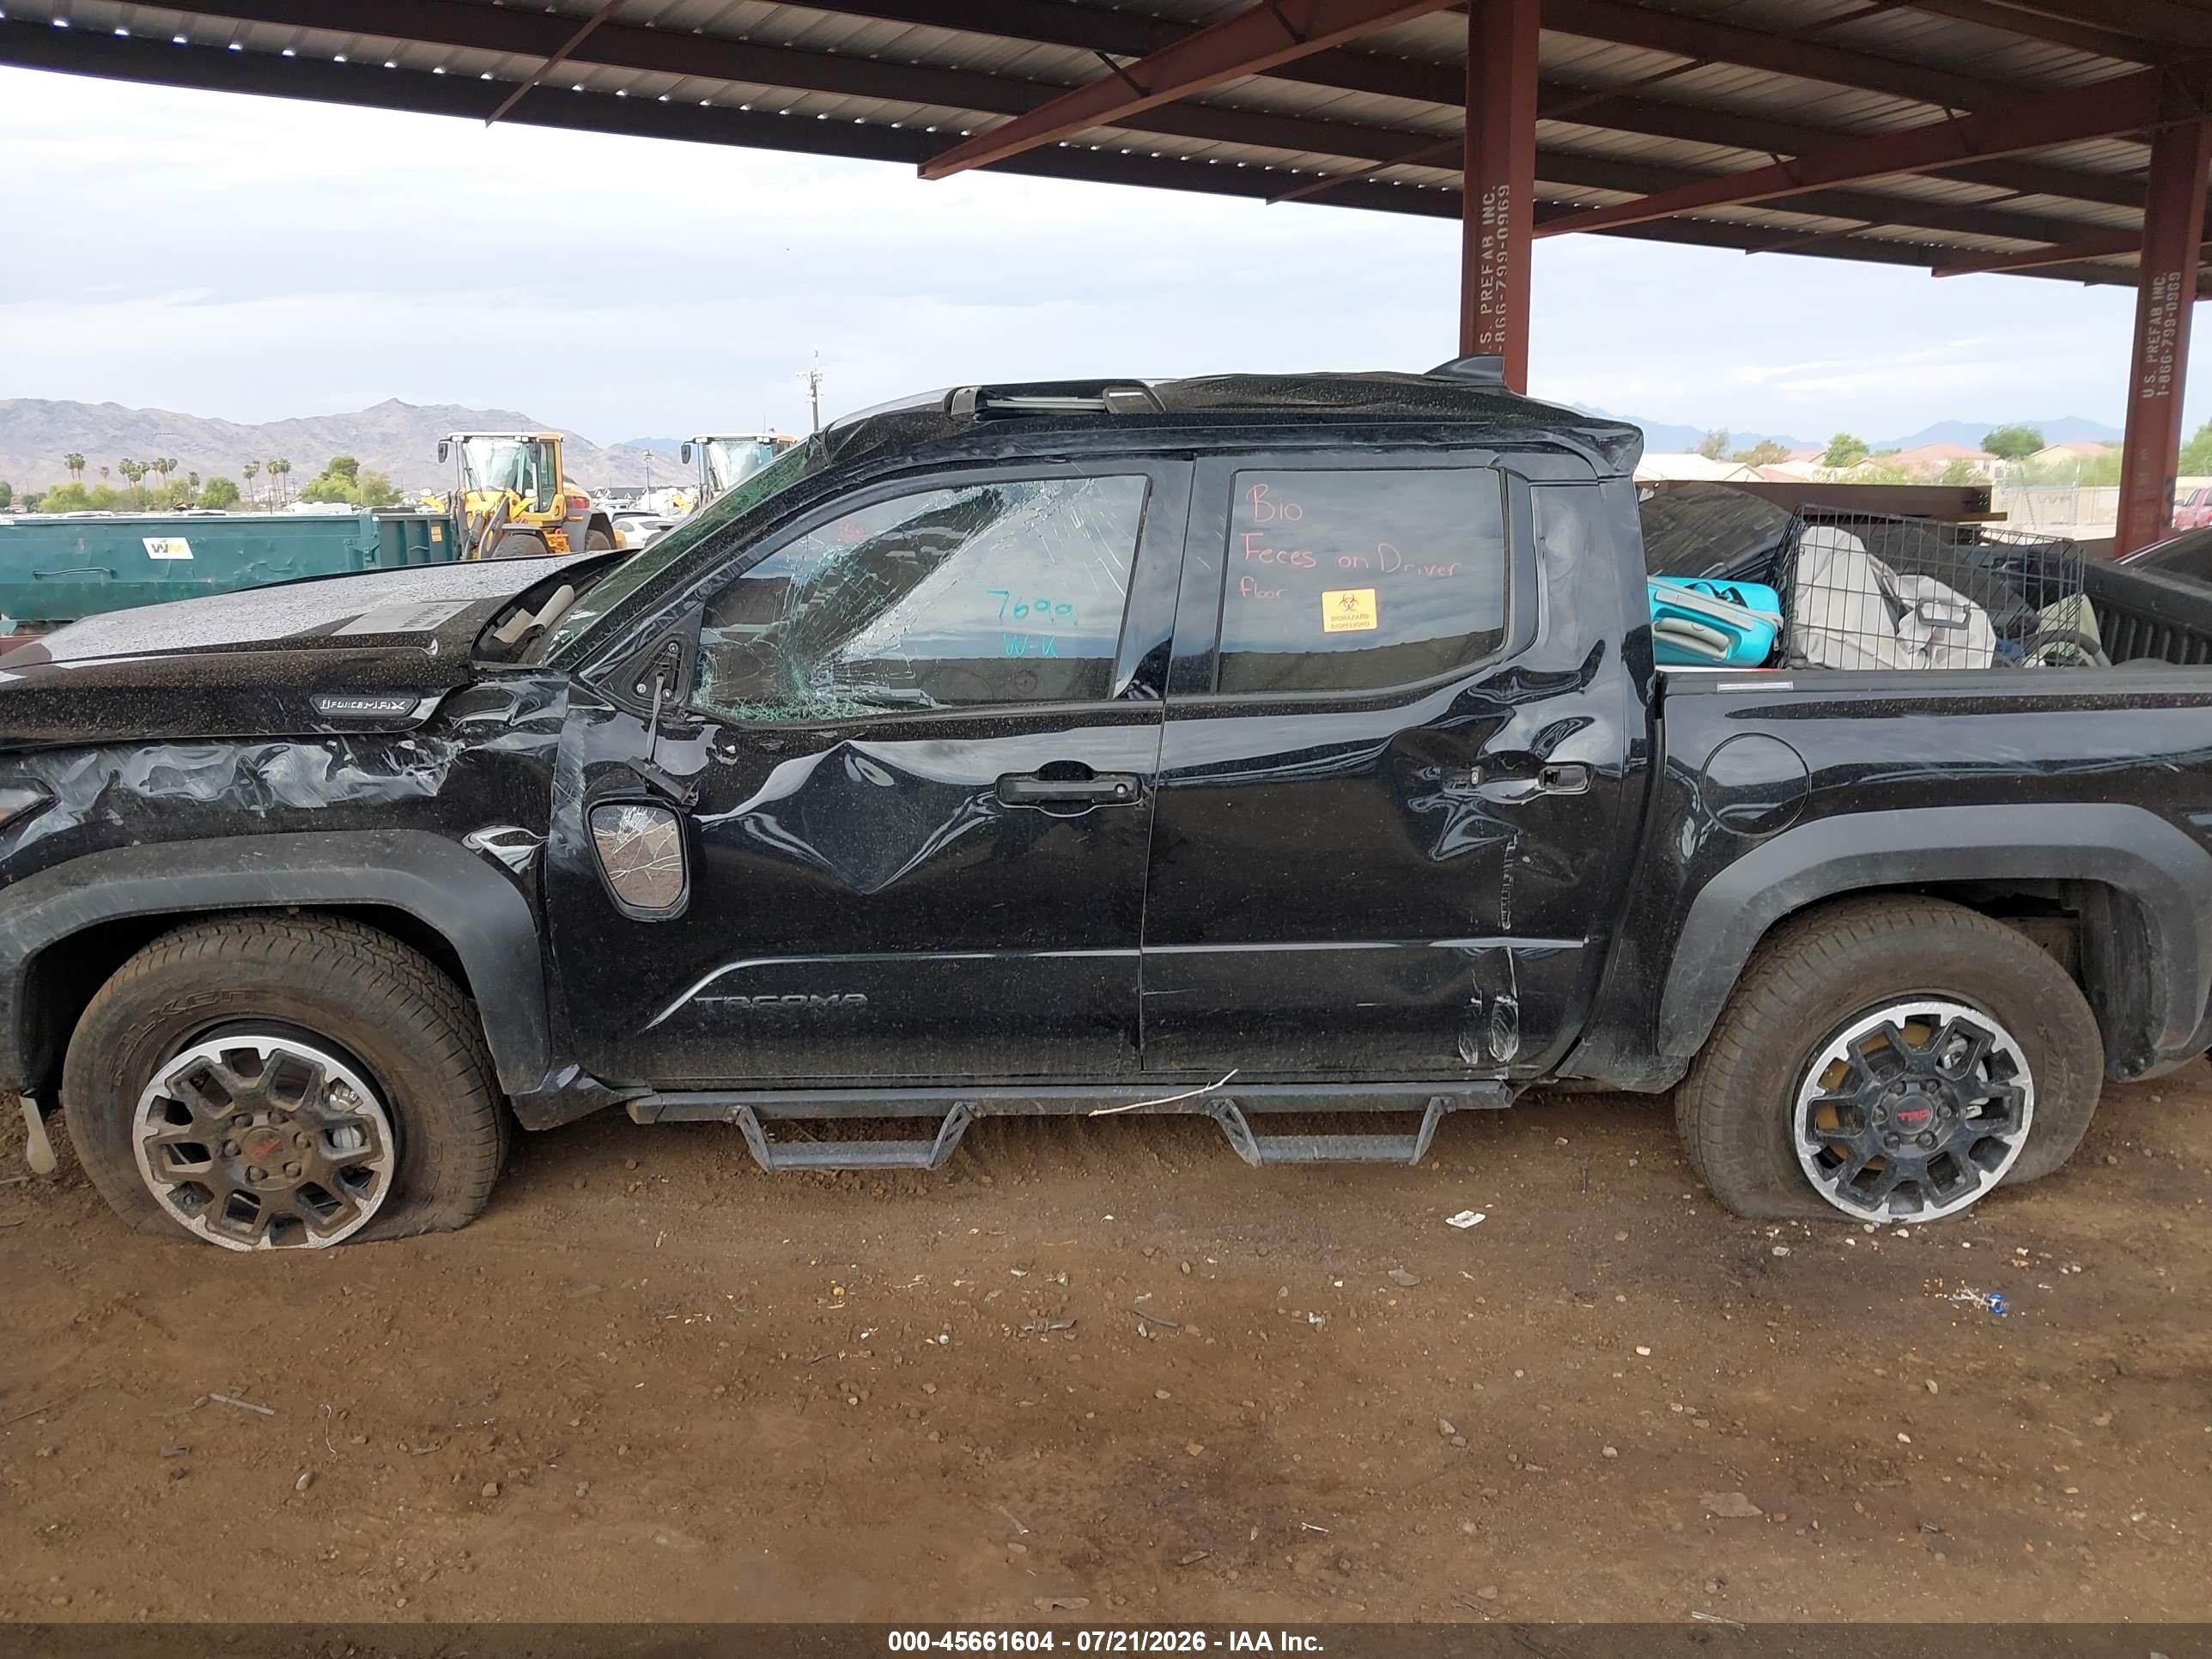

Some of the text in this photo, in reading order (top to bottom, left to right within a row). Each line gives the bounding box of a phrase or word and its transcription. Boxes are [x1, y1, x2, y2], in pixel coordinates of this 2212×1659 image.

[1482, 185, 1496, 225] INC.
[1480, 235, 1494, 314] PREFAB
[1495, 185, 1510, 352] -866-799-0969
[2142, 272, 2166, 398] U.S. PREFAB INC.
[2156, 271, 2182, 396] 1-866-799-0969
[1240, 532, 1461, 578] Feces on Driver
[694, 994, 869, 1010] TACOMA
